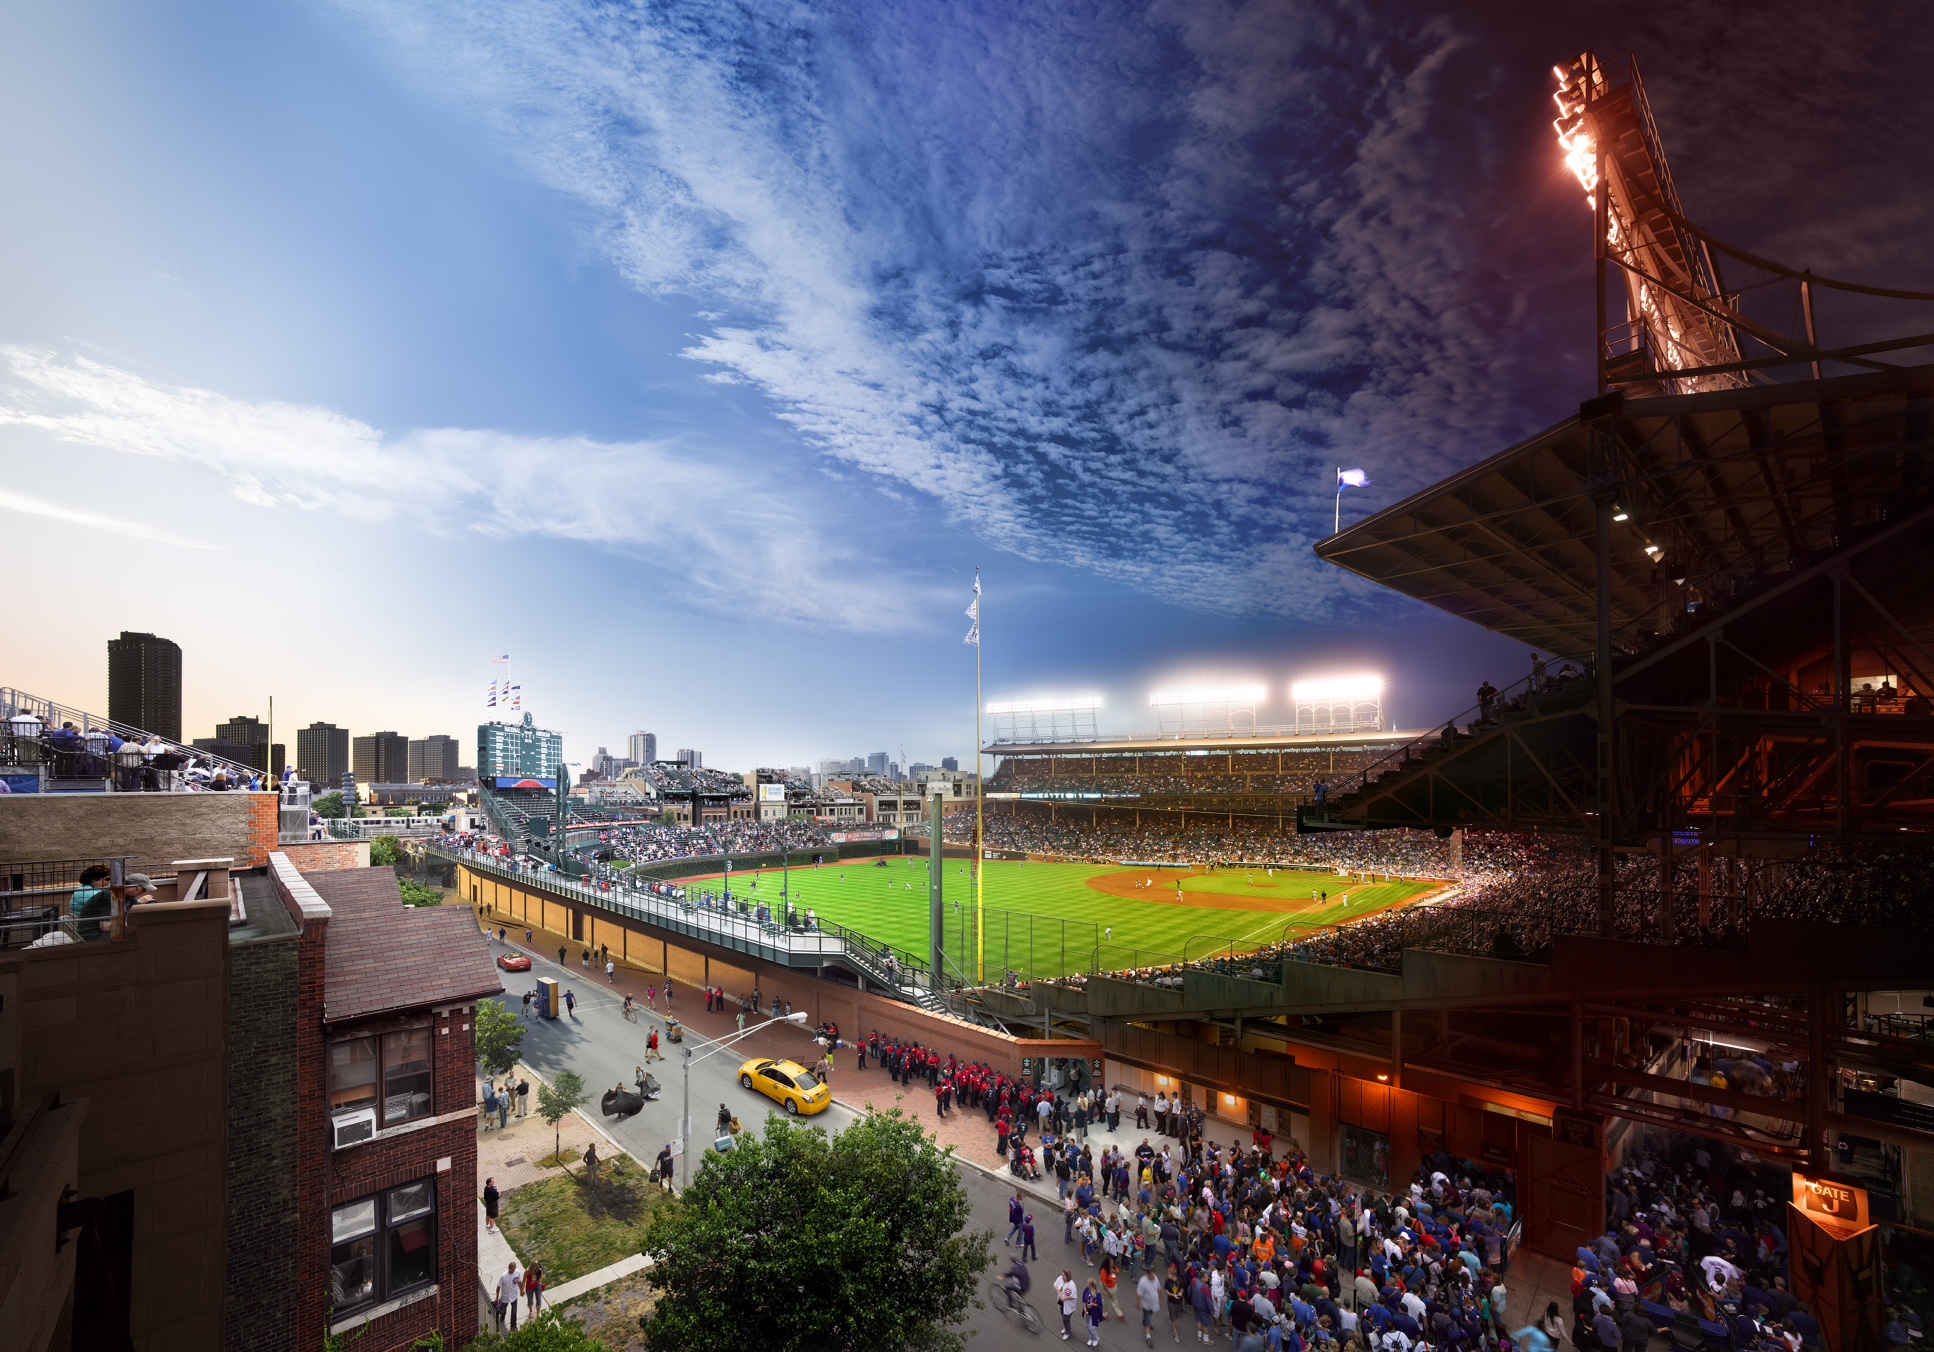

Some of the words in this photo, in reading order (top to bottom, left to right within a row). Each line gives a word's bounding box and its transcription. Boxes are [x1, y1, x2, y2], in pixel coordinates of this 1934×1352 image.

[1564, 1121, 1591, 1135] GATE
[1569, 1131, 1584, 1146] K
[1812, 1184, 1850, 1202] GATE
[1822, 1198, 1839, 1213] J
